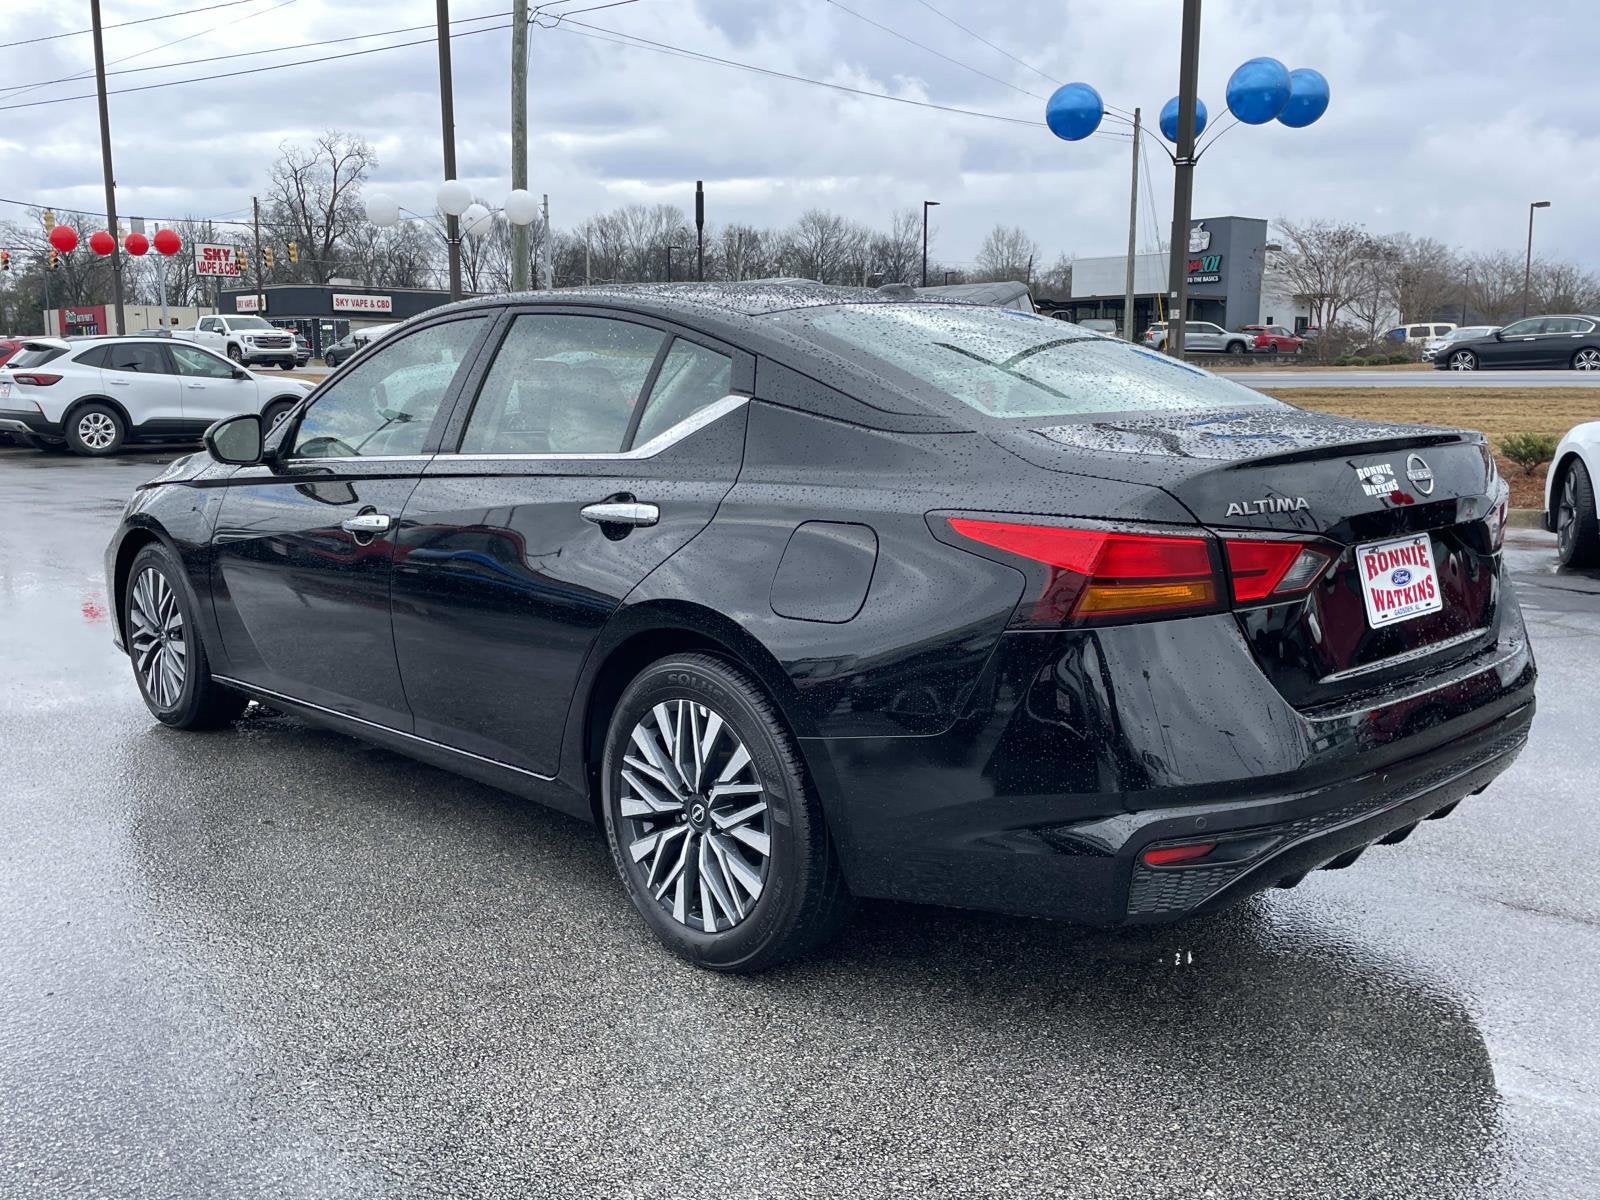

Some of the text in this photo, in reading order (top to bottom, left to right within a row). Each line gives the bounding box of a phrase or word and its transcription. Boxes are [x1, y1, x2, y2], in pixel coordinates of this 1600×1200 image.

[203, 247, 230, 261] SKY
[197, 261, 216, 274] VAPE
[218, 262, 224, 274] &
[335, 298, 390, 309] SKY VAPE & CBD
[1356, 463, 1394, 481] RONNIE
[1361, 478, 1399, 496] WATKINS
[1225, 497, 1310, 517] ALTIMA
[1364, 545, 1430, 581] RONNIE
[1392, 569, 1411, 585] Ford
[1370, 574, 1435, 612] WATKINS
